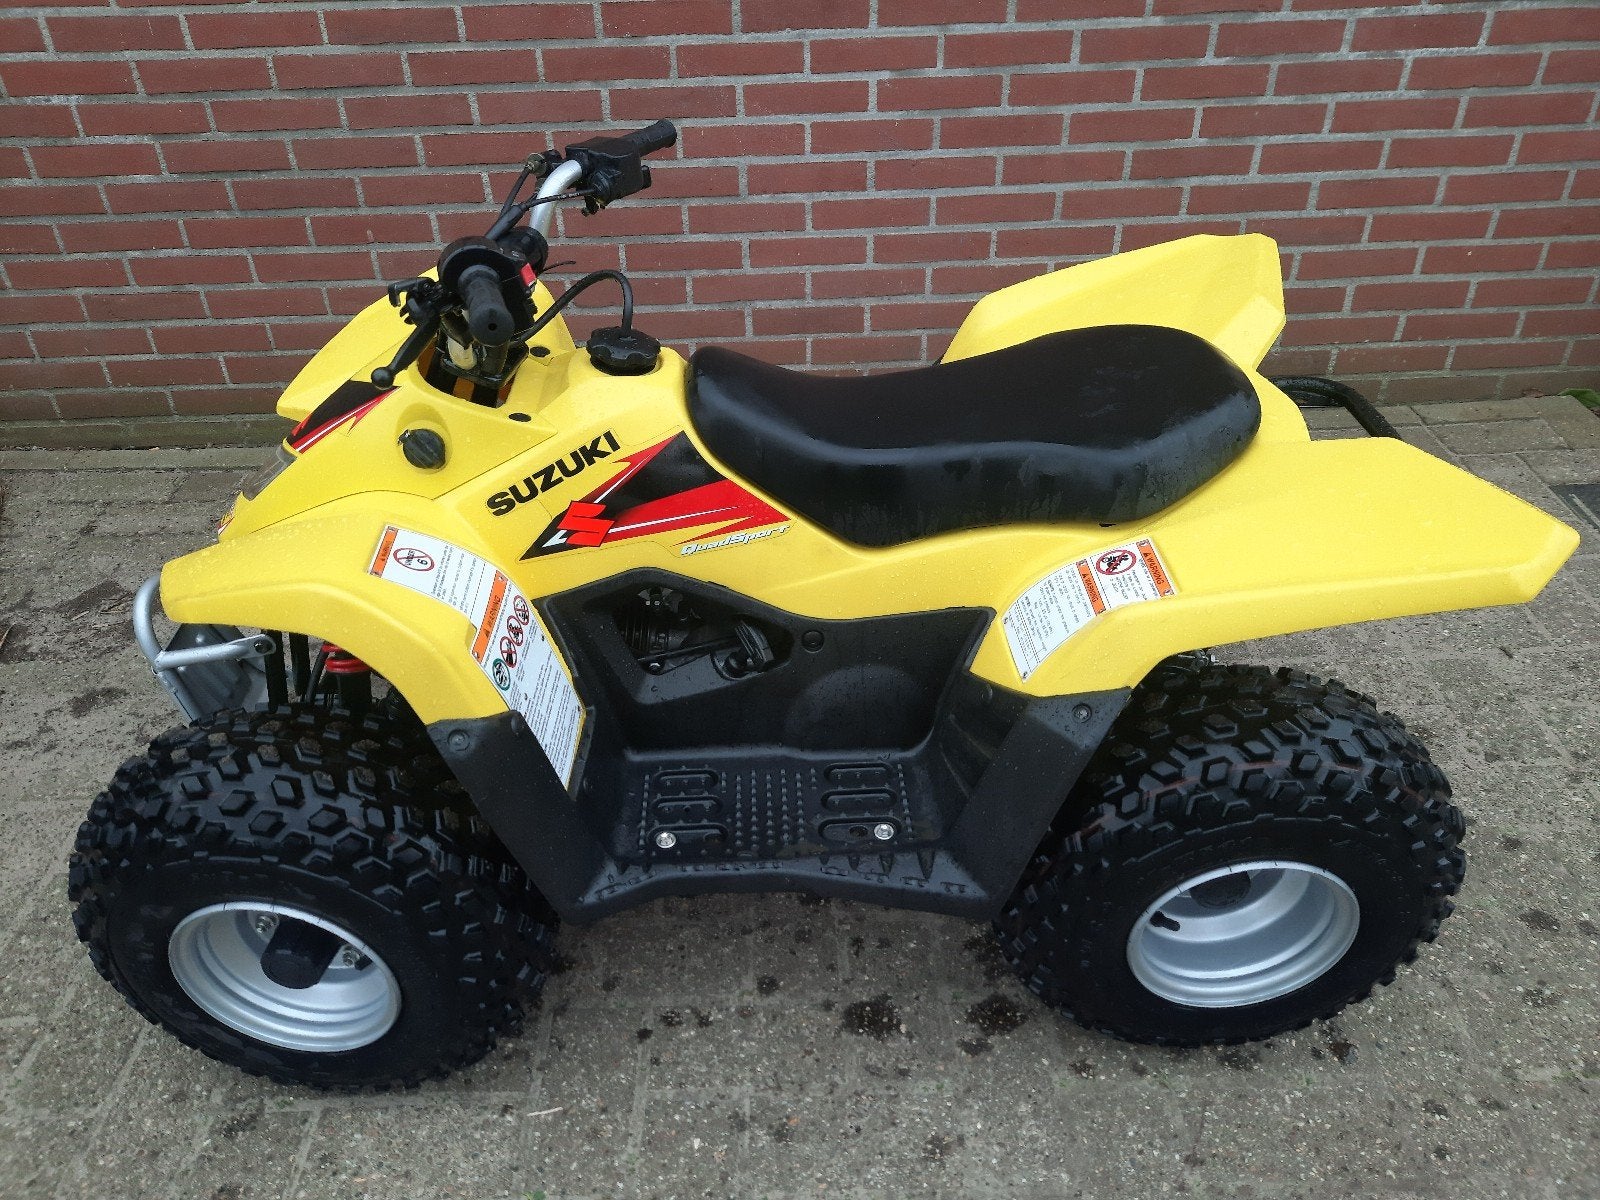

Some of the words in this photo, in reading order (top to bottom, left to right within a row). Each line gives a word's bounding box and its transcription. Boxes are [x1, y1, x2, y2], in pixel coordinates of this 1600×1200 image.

[486, 430, 621, 516] SUZUKI
[680, 525, 790, 556] QuadSport
[417, 558, 429, 566] 6
[1147, 555, 1165, 586] WARNING
[1084, 578, 1099, 604] WARNING
[487, 594, 502, 629] WARNING
